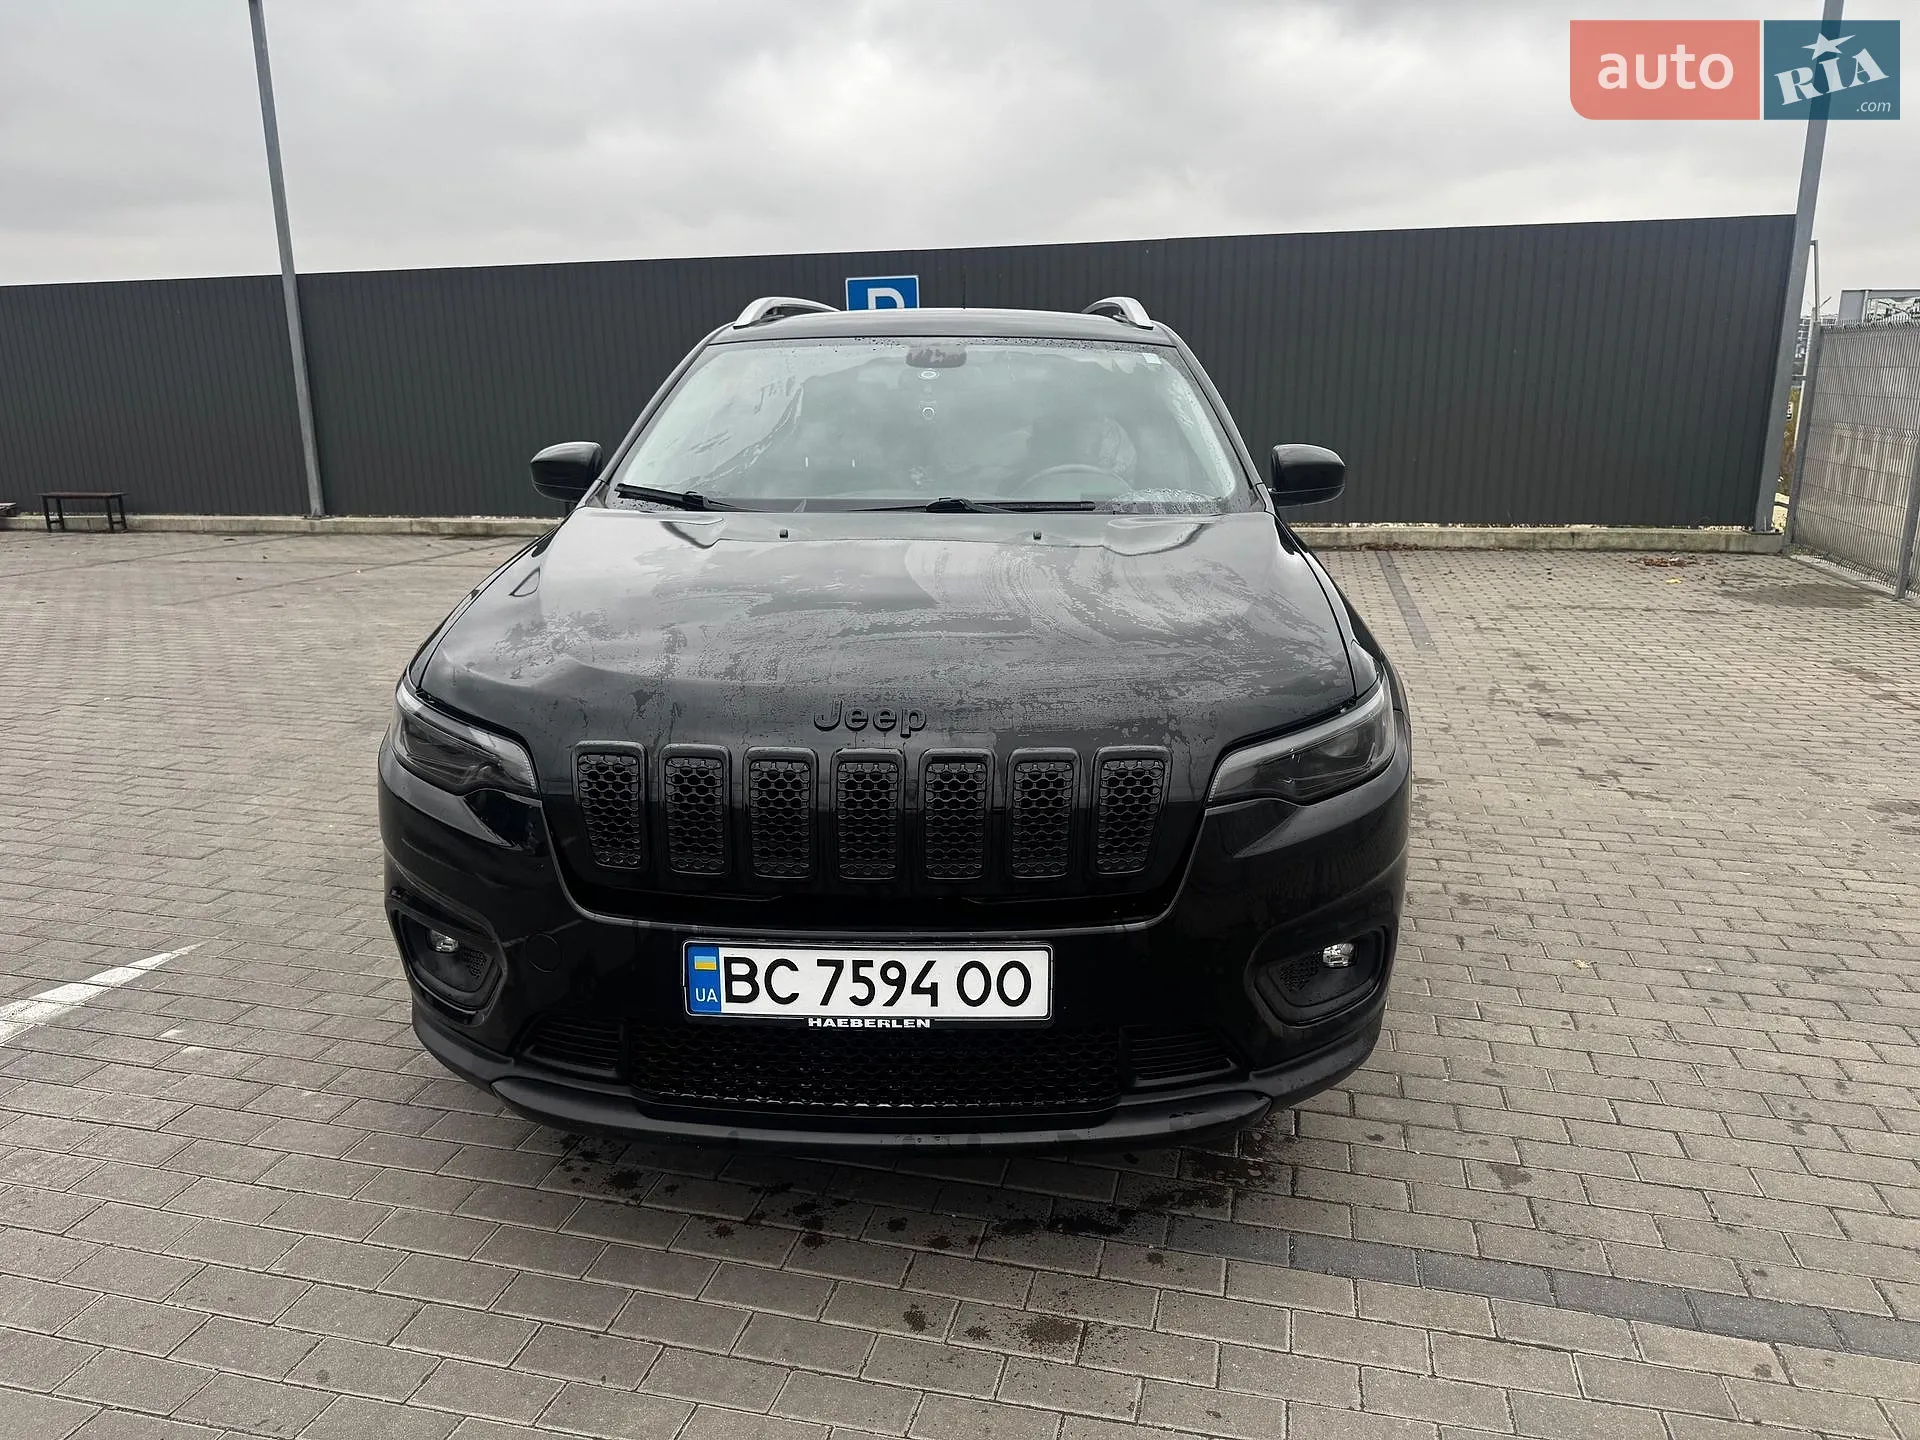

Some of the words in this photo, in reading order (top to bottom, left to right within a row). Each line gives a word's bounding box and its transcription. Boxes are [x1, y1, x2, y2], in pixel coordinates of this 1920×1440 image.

[814, 699, 926, 738] Jeep
[724, 956, 799, 1005] BC
[816, 958, 938, 1007] 7594
[695, 988, 718, 1003] UA
[808, 1018, 930, 1028] HAEBERLEN
